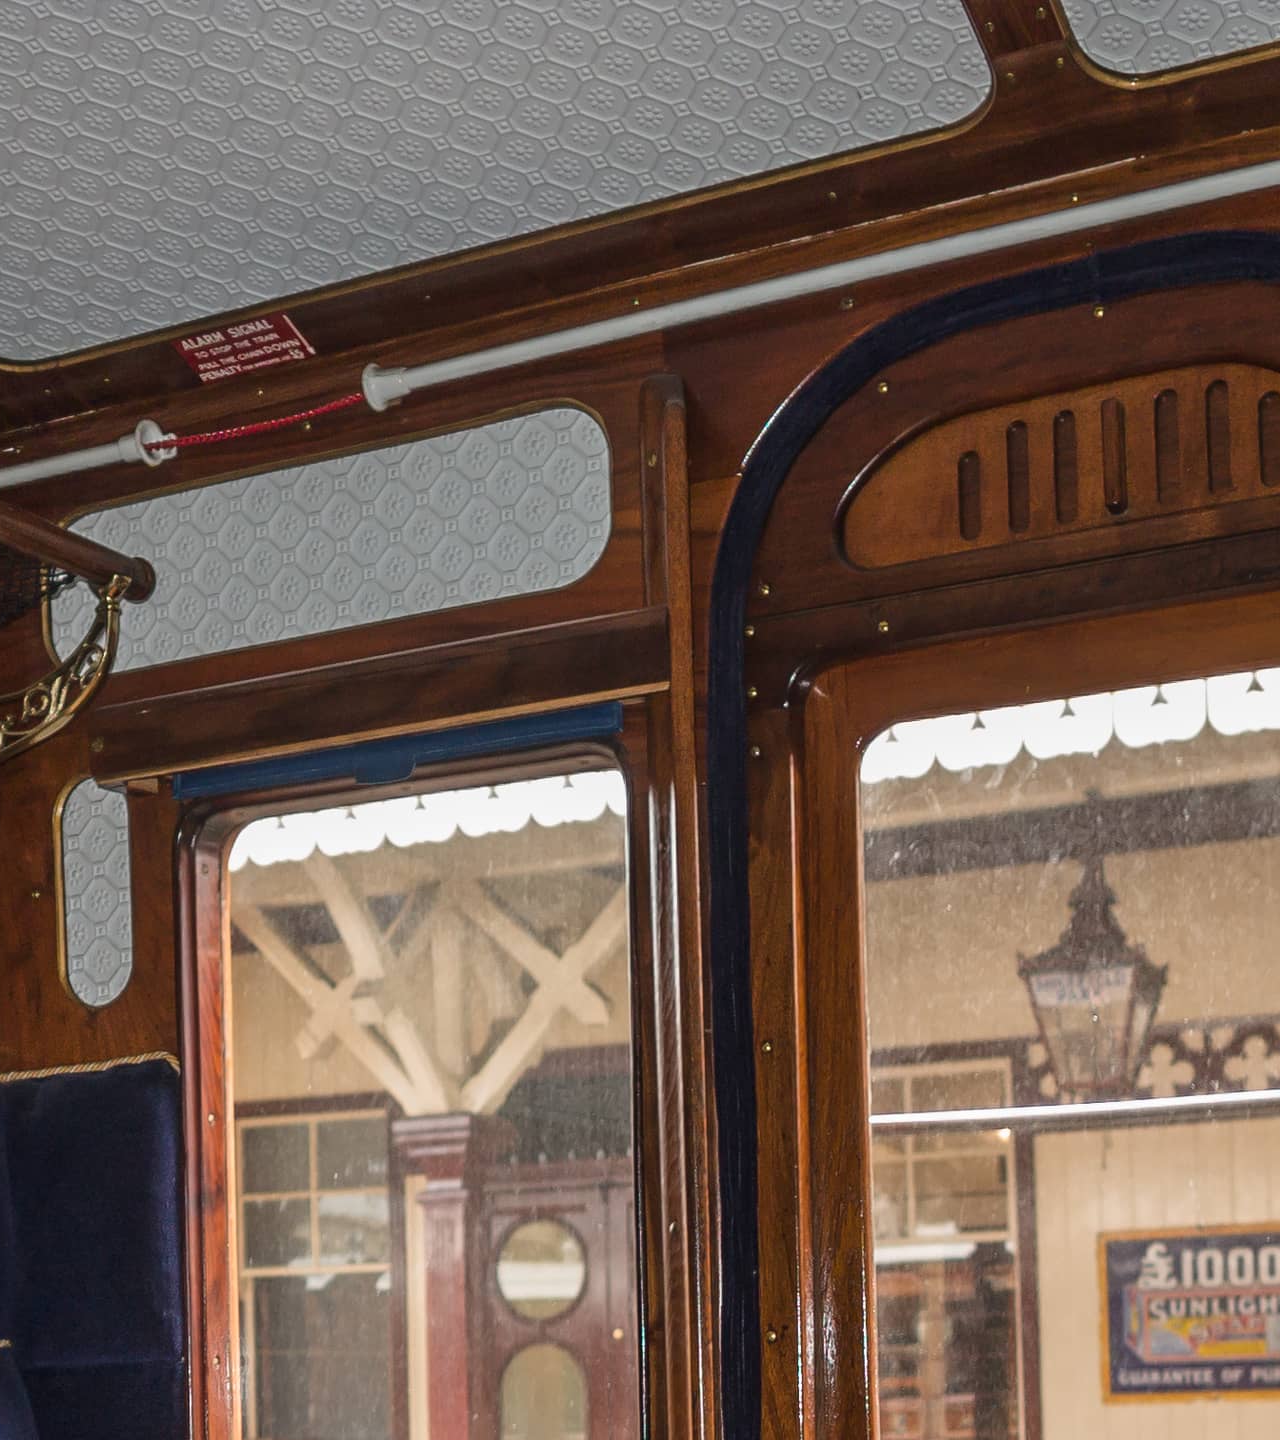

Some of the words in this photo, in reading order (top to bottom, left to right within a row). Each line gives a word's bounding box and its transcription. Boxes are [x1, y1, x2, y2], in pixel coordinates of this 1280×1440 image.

[181, 331, 225, 350] ALARM
[227, 319, 274, 339] SIGNAL
[263, 338, 302, 355] DOWN
[199, 365, 243, 382] PENALTY
[1118, 1366, 1215, 1387] GUARANTEE
[1222, 1365, 1244, 1384] OF
